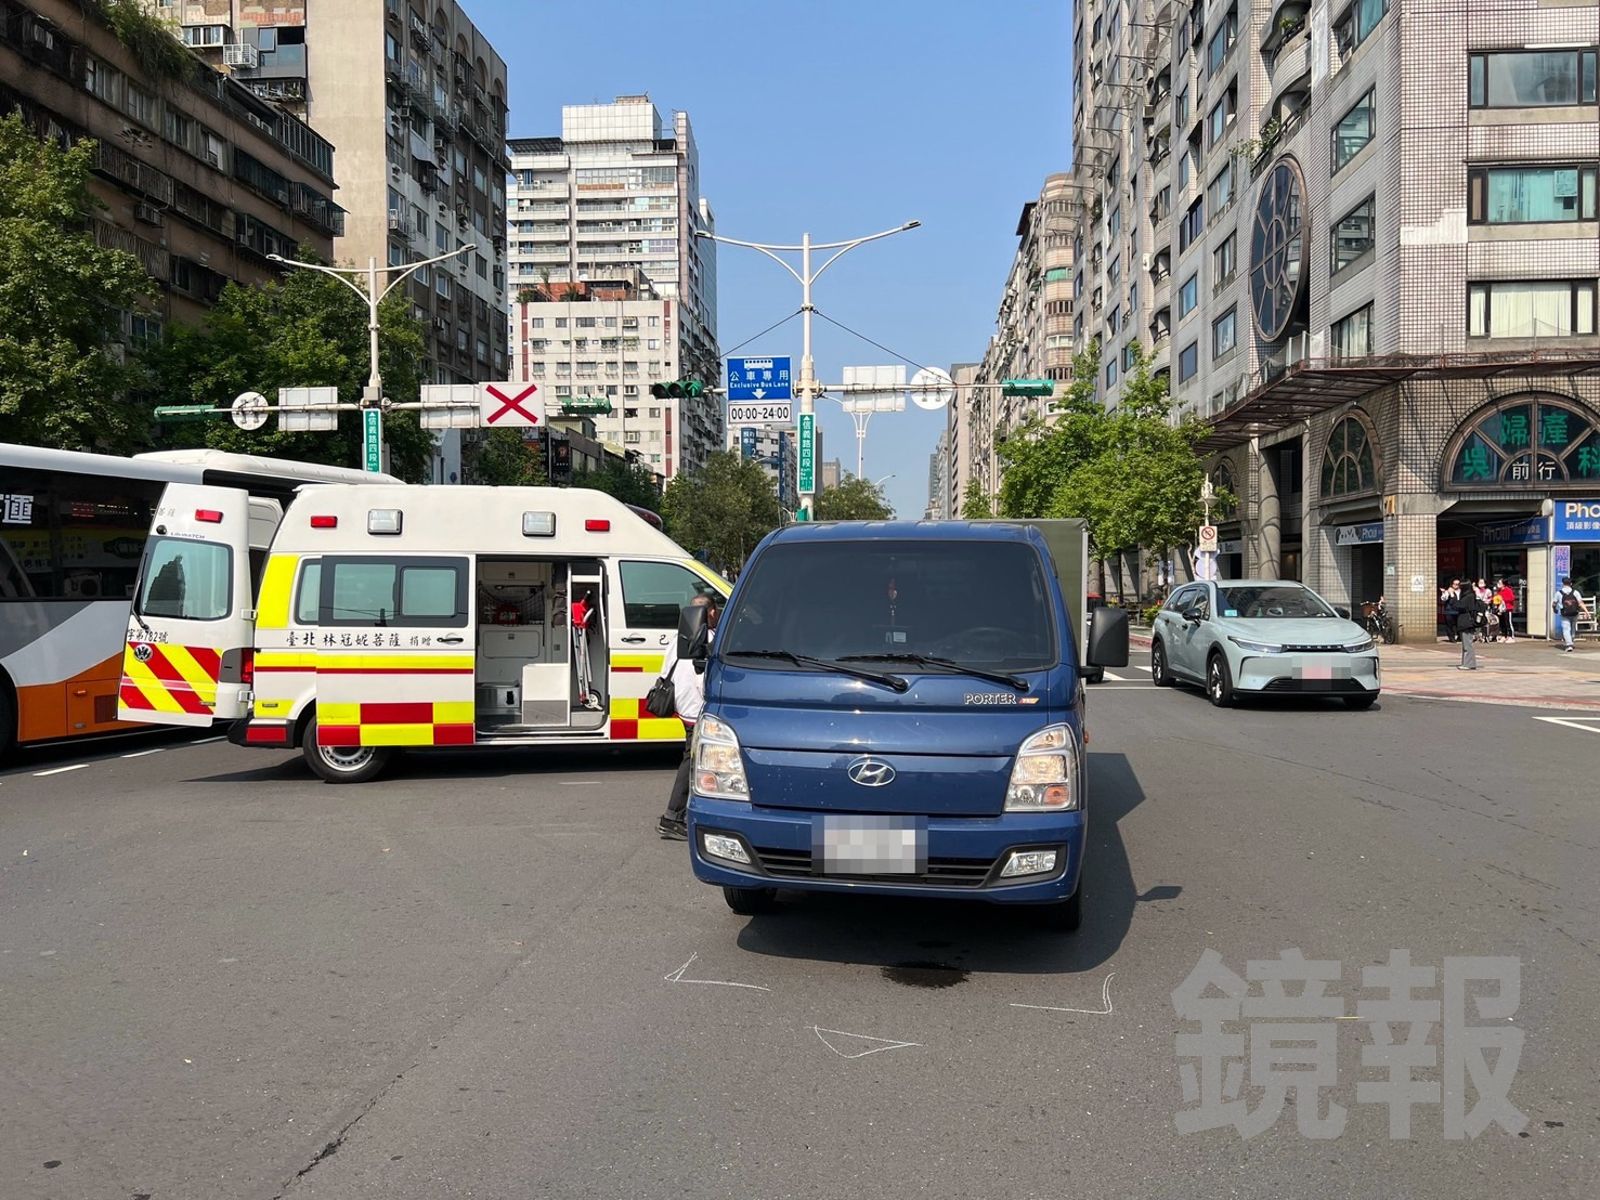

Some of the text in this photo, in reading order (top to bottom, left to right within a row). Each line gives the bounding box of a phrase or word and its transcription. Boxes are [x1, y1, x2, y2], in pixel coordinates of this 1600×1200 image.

[729, 370, 788, 381] 公車專用
[368, 417, 378, 463] 信義路四段
[802, 421, 812, 467] 信義路四段
[1512, 461, 1556, 480] 前行
[0, 494, 34, 524] 運
[963, 692, 1017, 706] PORTER
